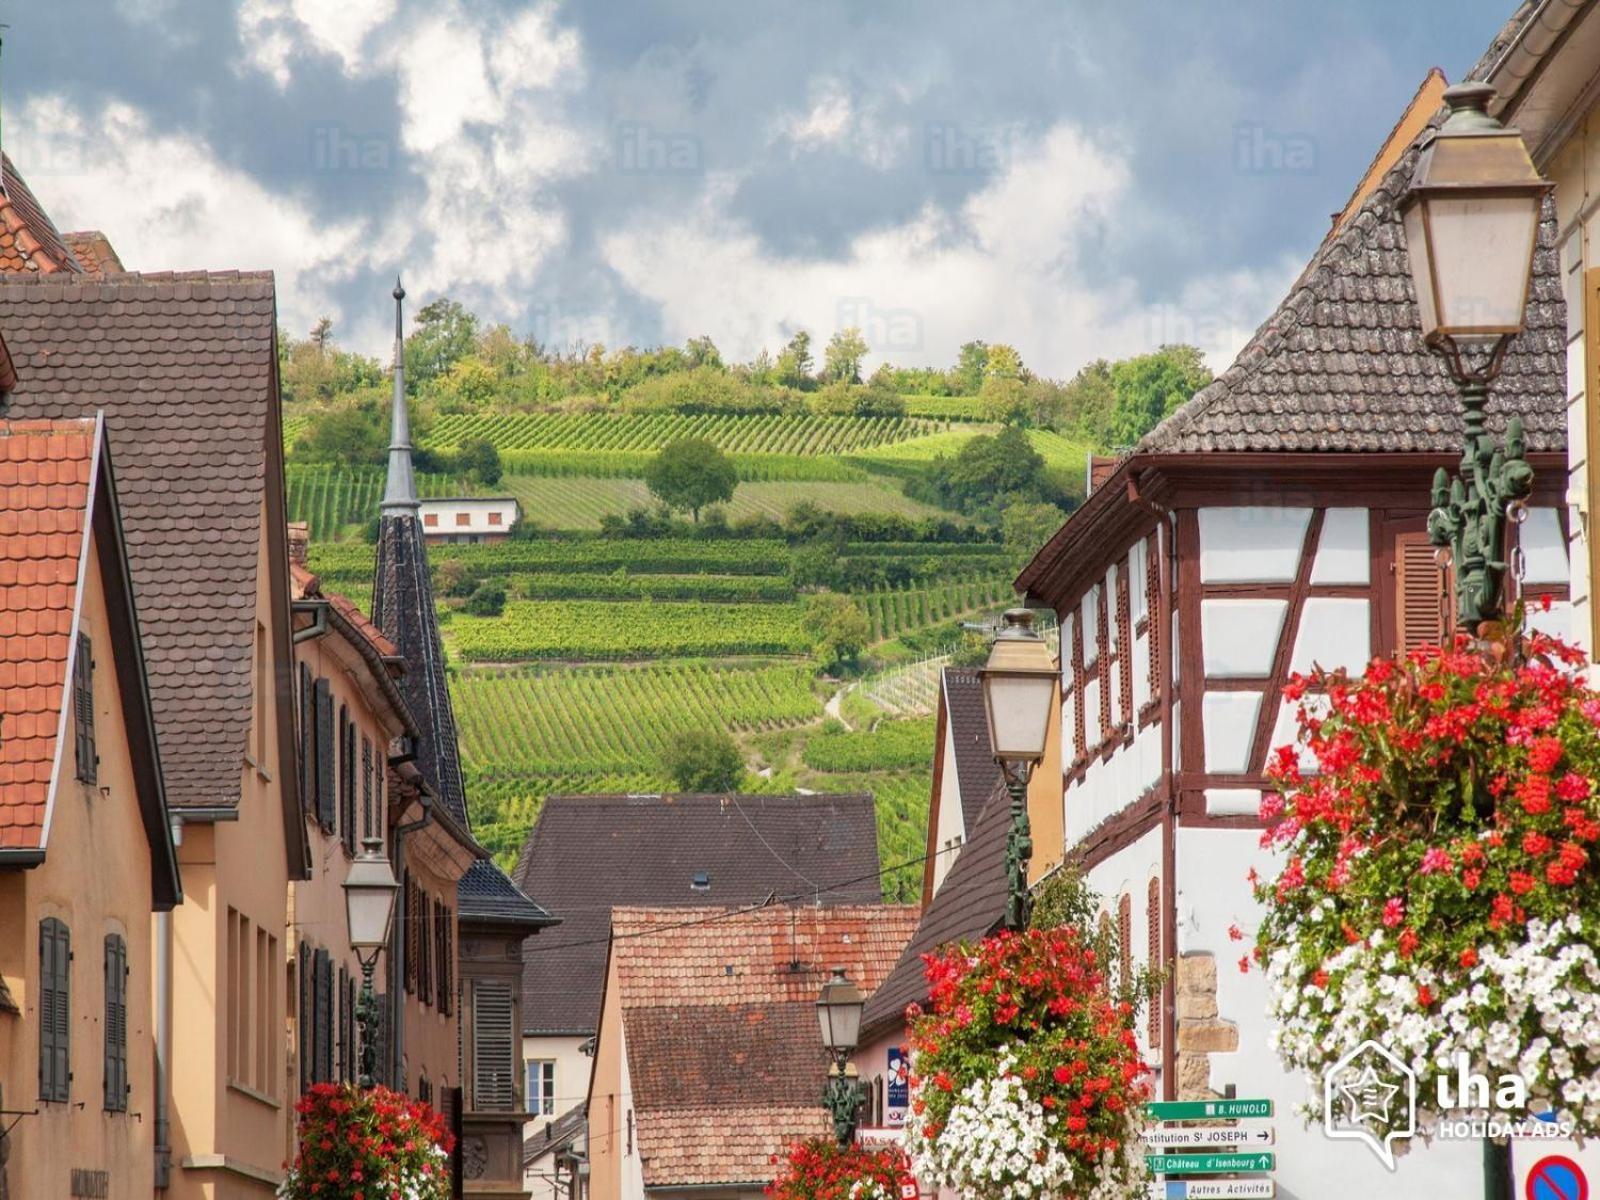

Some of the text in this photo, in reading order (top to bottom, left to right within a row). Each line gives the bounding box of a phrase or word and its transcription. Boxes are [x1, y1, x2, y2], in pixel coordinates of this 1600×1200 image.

[1229, 1104, 1268, 1115] HUNOLD
[1207, 1132, 1248, 1142] JOSEPH
[1166, 1157, 1256, 1169] Château d'Isenbourg
[1190, 1183, 1271, 1194] Autres Activités
